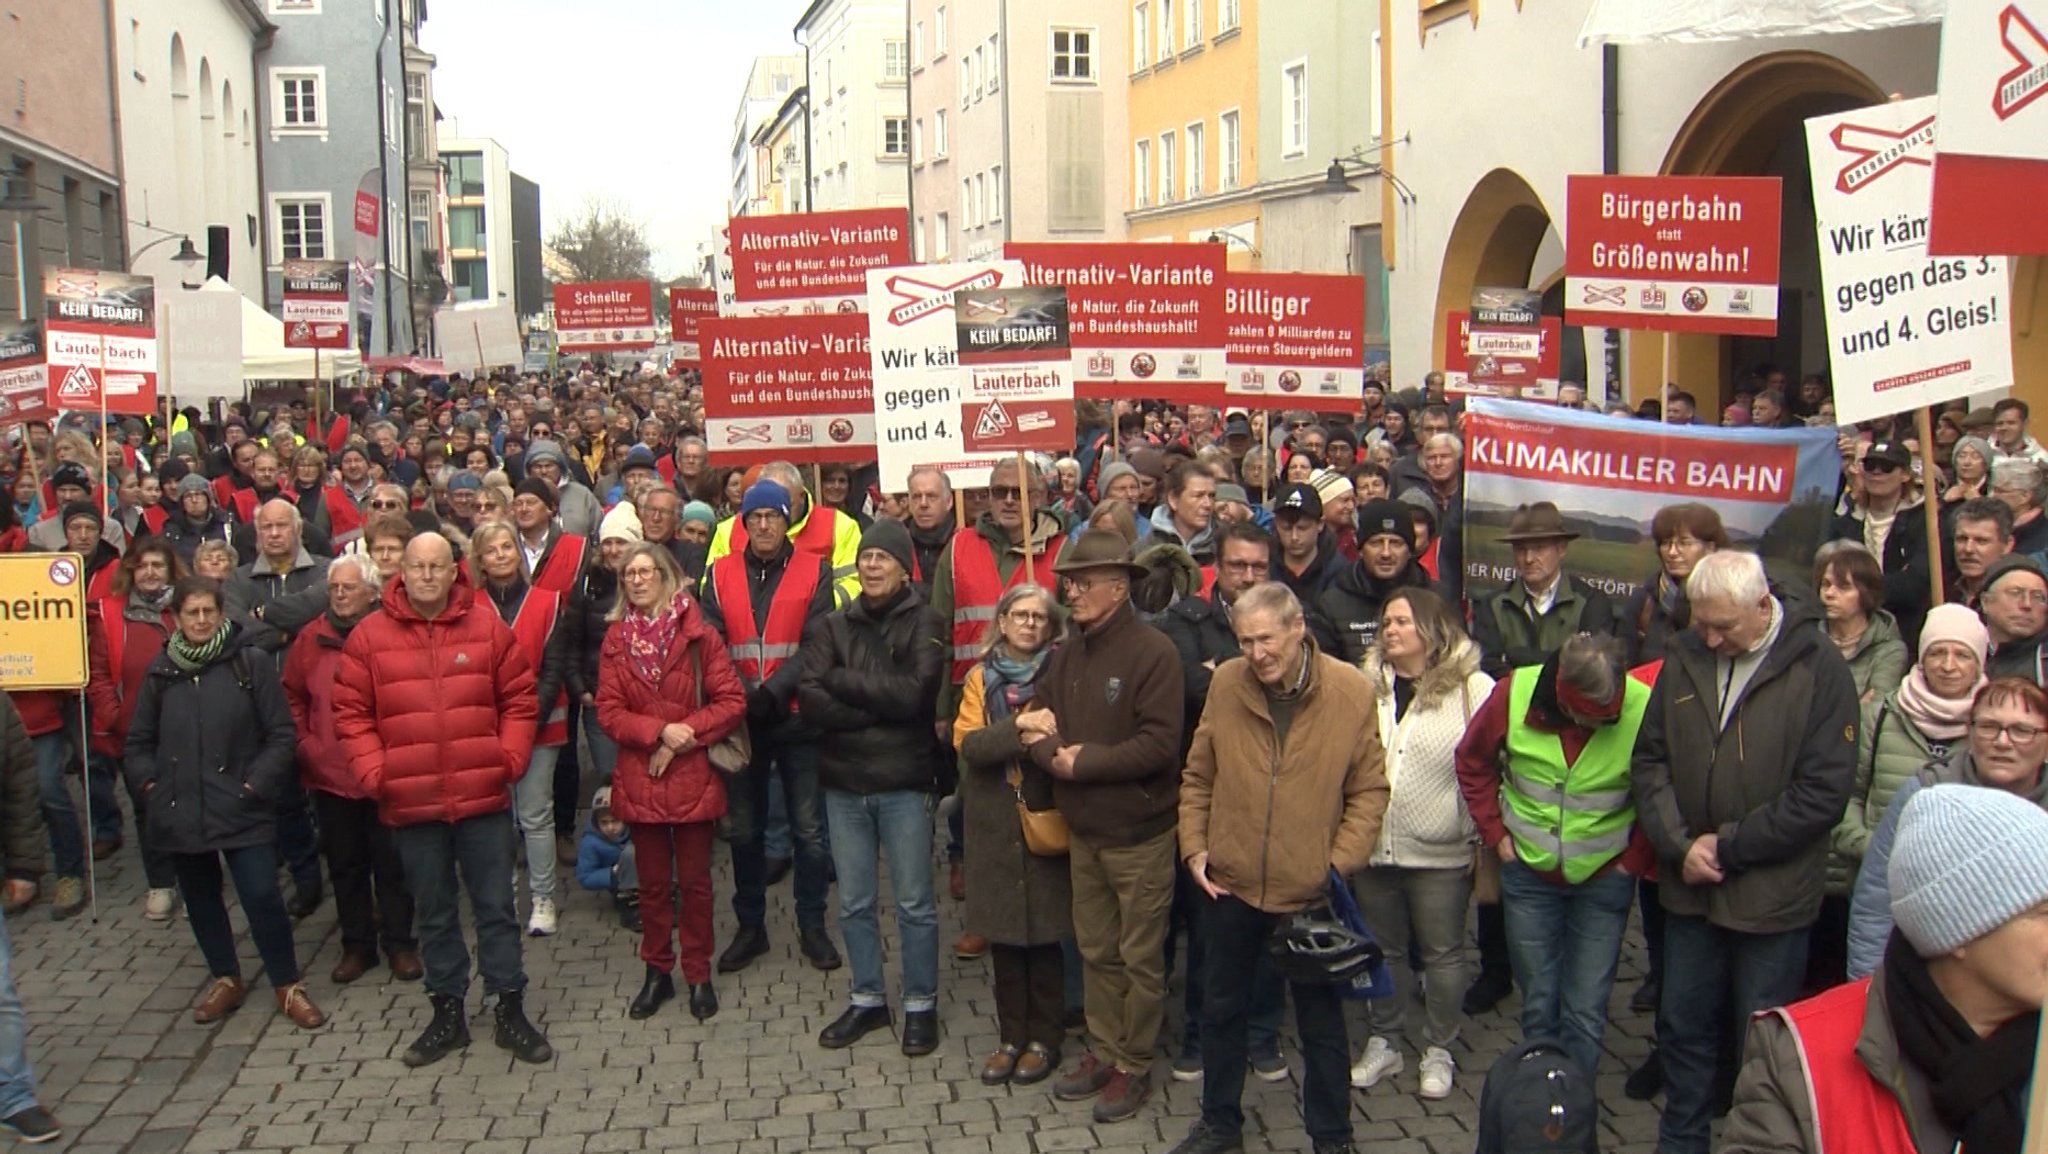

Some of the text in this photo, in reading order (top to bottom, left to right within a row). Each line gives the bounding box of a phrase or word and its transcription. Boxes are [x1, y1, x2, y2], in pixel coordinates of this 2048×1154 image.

[1601, 192, 1742, 226] Bürgerbahn
[741, 225, 898, 251] Alternativ-Variante
[1656, 229, 1681, 241] statt
[1830, 224, 1874, 255] Wir
[754, 260, 772, 273] Für
[775, 259, 791, 272] die
[829, 256, 846, 269] die
[849, 253, 889, 267] Zukunft
[1592, 242, 1750, 274] Größenwahn!
[290, 280, 342, 292] KEIN BEDARF!
[756, 277, 776, 289] und
[779, 275, 798, 288] den
[1837, 255, 1996, 313] gegen das 3.
[574, 290, 632, 305] Schneller
[1125, 299, 1145, 313] die
[1150, 299, 1199, 314] Zukunft
[1225, 288, 1311, 322] Billiger
[60, 301, 143, 322] KEIN BEDARF!
[287, 305, 343, 316] Lauterbach
[1479, 310, 1534, 323] KEIN BEDARF!
[970, 325, 1057, 345] KEIN BEDARF!
[1089, 319, 1198, 334] Bundeshaushalt!
[1228, 324, 1264, 338] zahlen
[1278, 326, 1334, 340] Milliarden
[1338, 329, 1351, 340] zu
[1842, 296, 1997, 355] und 4. Gleis!
[1225, 341, 1353, 360] unseren Steuergeldern
[1478, 335, 1532, 350] Lauterbach
[881, 348, 918, 369] Wir
[728, 371, 750, 385] Für
[754, 370, 774, 384] die
[820, 368, 839, 381] die
[973, 370, 1061, 391] Lauterbach
[731, 385, 875, 404] und den Bundeshaush
[884, 386, 950, 413] gegen
[887, 419, 953, 443] und 4.
[1471, 436, 1784, 494] KLIMAKILLER BAHN
